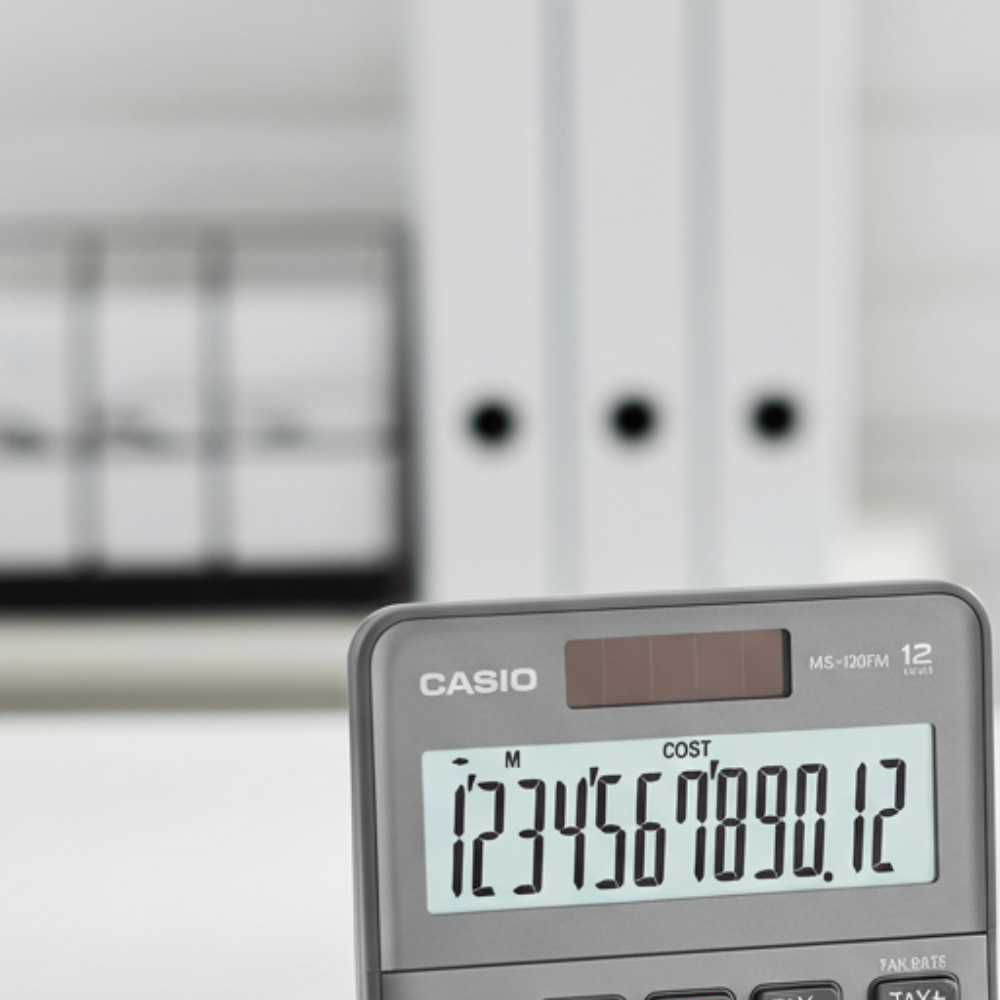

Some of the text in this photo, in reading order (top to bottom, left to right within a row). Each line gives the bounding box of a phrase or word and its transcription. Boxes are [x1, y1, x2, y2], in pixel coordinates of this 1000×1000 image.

[809, 653, 890, 670] MS-120FM
[901, 642, 933, 665] 12
[419, 667, 538, 696] CASIO
[505, 750, 521, 768] M
[663, 740, 712, 759] COST
